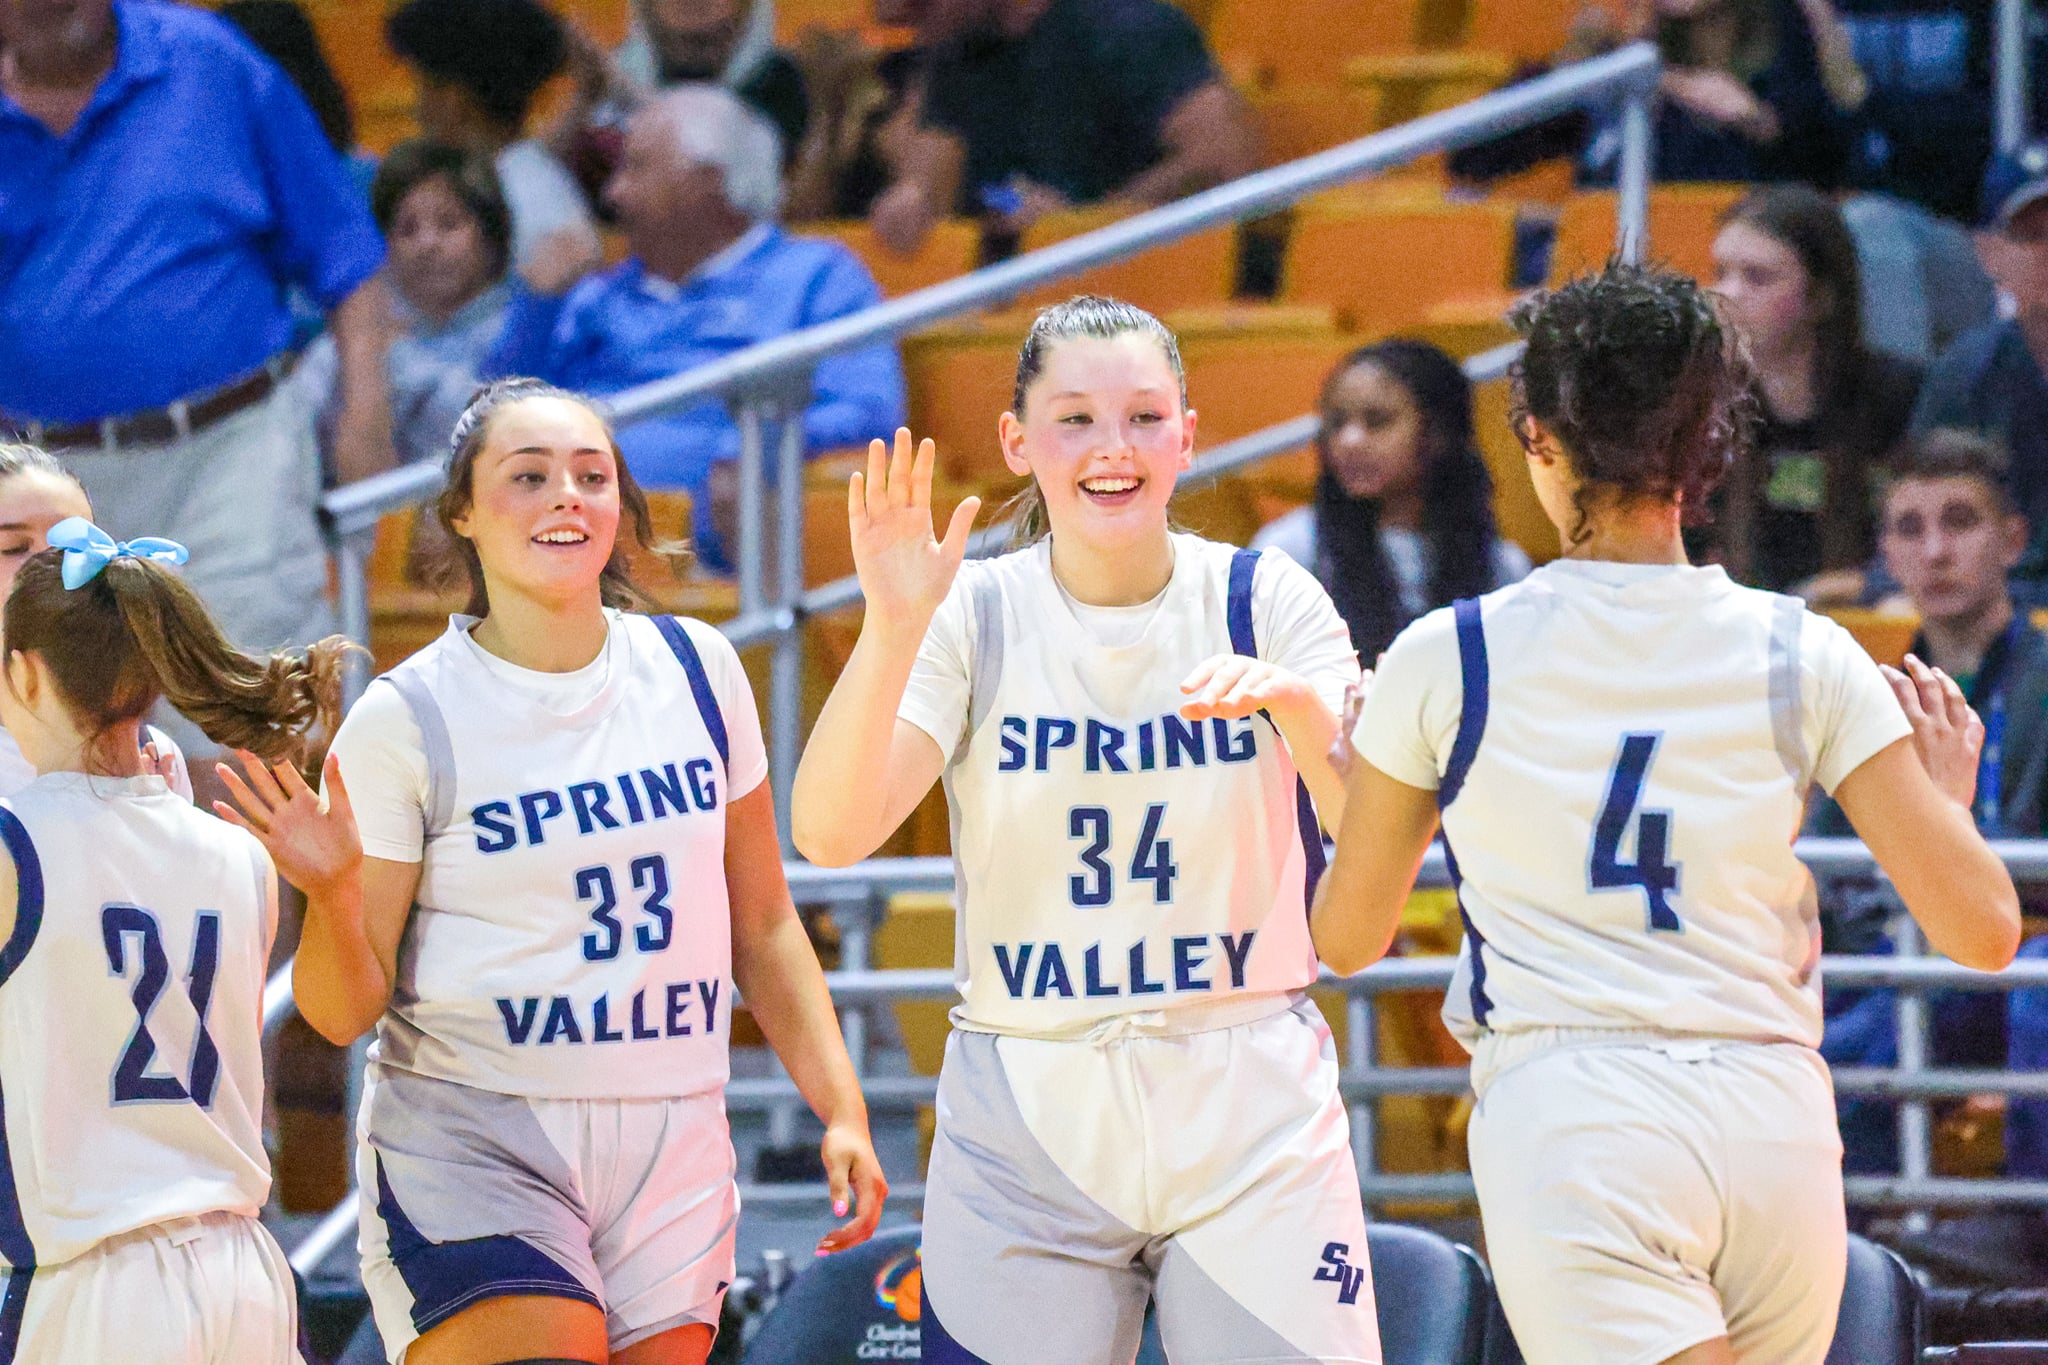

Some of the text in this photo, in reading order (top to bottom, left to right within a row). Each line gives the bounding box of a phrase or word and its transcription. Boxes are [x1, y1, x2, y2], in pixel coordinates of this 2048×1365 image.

[998, 713, 1259, 773] SPRING
[472, 757, 718, 855] SPRING
[1588, 731, 1684, 933] 4
[1067, 803, 1178, 908] 34
[575, 852, 675, 963] 33
[102, 902, 221, 1110] 21
[496, 978, 721, 1046] VALLEY
[992, 931, 1256, 999] VALLEY
[1313, 1241, 1364, 1305] SV
